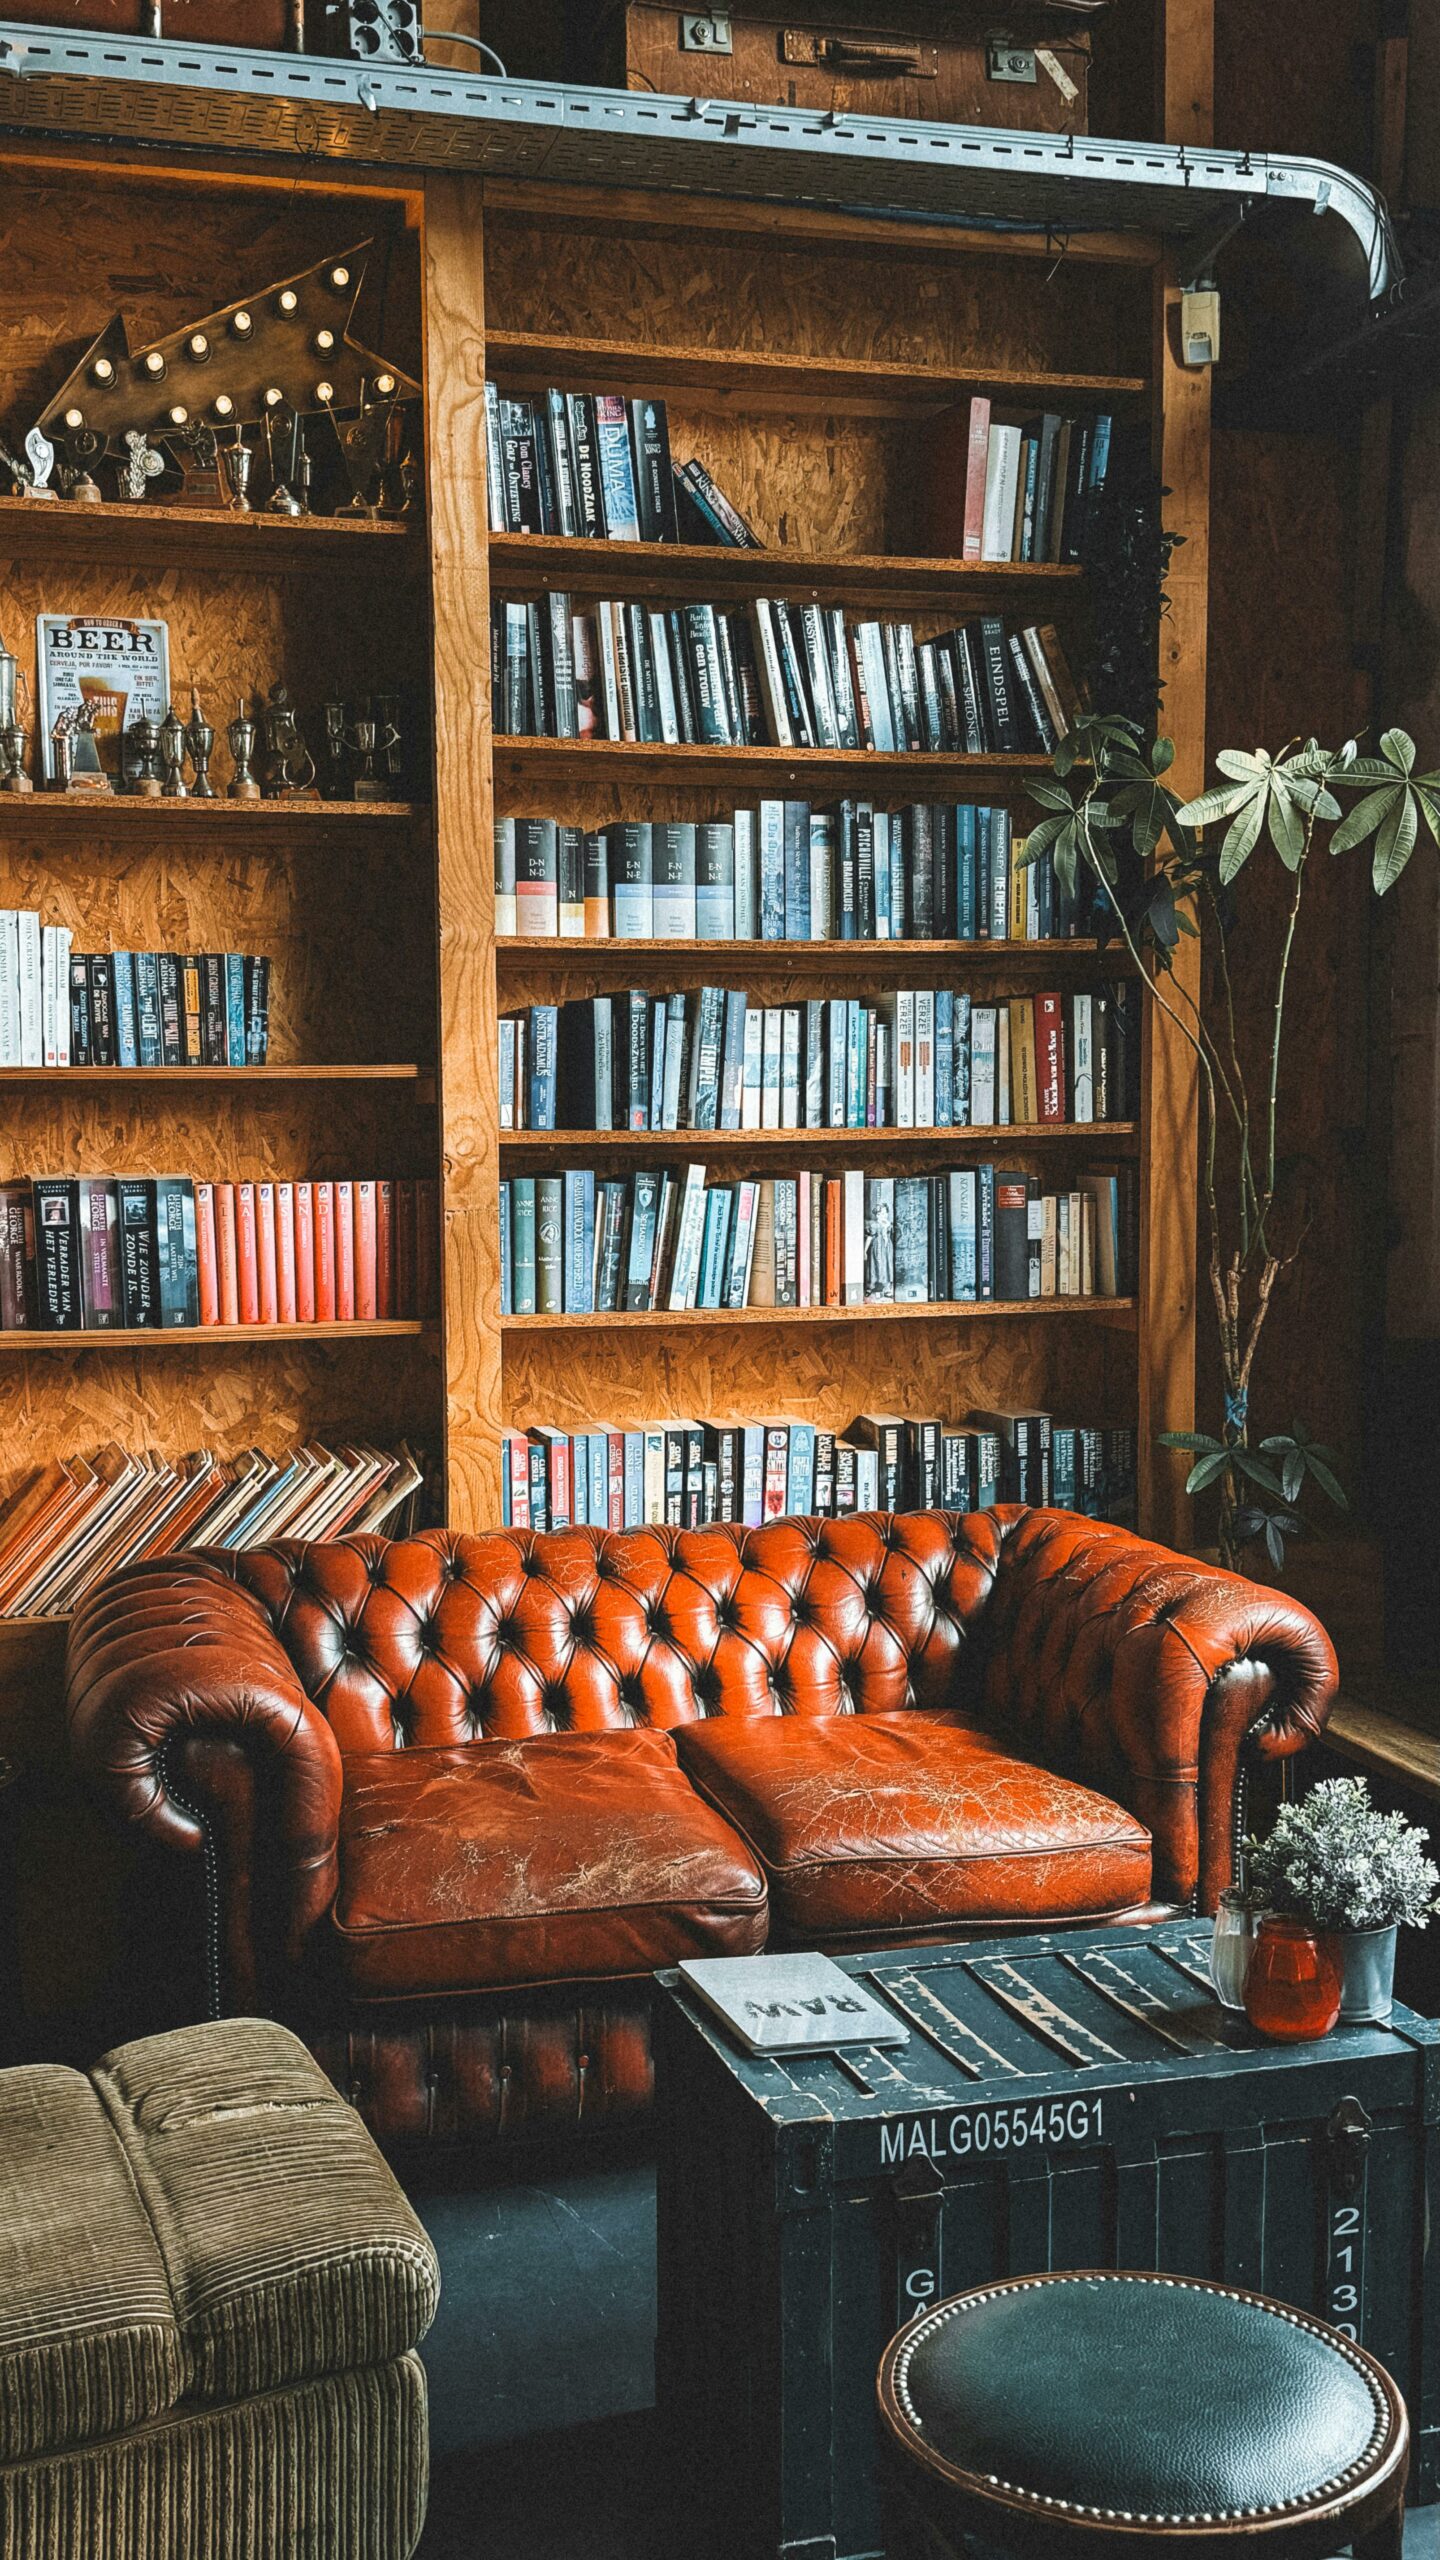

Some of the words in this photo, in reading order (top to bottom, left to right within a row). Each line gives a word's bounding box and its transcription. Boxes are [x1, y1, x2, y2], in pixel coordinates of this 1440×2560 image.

[519, 440, 531, 459] Tom
[604, 427, 626, 493] DUMA
[521, 461, 533, 490] Clancy
[508, 472, 522, 523] ONTZETTING
[581, 463, 596, 522] NOODZAAK
[729, 515, 749, 538] GREEN
[49, 629, 155, 652] BEER
[695, 644, 705, 667] een
[698, 668, 711, 708] vrouw
[989, 646, 1010, 727] EINDSPEL
[962, 687, 977, 738] SPELONK
[529, 858, 545, 867] D-N
[626, 861, 641, 870] E-N
[668, 862, 683, 870] F-N
[708, 863, 723, 871] E-N
[858, 829, 872, 881] PSYCHOVILLE
[529, 868, 546, 877] N-D
[626, 871, 642, 879] N-E
[668, 872, 683, 880] N-F
[708, 873, 723, 881] N-E
[843, 860, 854, 913] BRANDKLUIS
[569, 890, 577, 898] N
[114, 959, 125, 997] GRISHAM
[124, 965, 133, 988] JOHN
[138, 959, 148, 997] GRISHAM
[147, 965, 156, 988] JOHN
[160, 958, 169, 996] GRISHAM
[167, 964, 177, 987] JOHN
[206, 958, 218, 975] JOHN
[228, 954, 241, 973] JOHN
[101, 989, 109, 1022] ADVOCAAT
[208, 976, 219, 1006] GRISHAM
[230, 975, 242, 1005] GRISHAM
[94, 999, 102, 1023] DUIVEL
[121, 1003, 135, 1048] RAINMAKER
[141, 1013, 158, 1040] CLIENT
[899, 999, 908, 1036] VERZET
[917, 999, 927, 1036] VERZET
[164, 1029, 180, 1047] KILL
[535, 1012, 548, 1077] NOSTRADAMUS
[631, 1014, 640, 1091] DOODSZWAARD
[698, 1043, 718, 1087] TEMPEL
[90, 1194, 100, 1232] GEORGE
[98, 1194, 107, 1231] ELIZABETH
[168, 1194, 177, 1231] GEORGE
[175, 1194, 183, 1230] ELIZABETH
[241, 1206, 251, 1217] A
[319, 1205, 328, 1215] D
[779, 1182, 787, 1226] COOKSON
[960, 1177, 969, 1221] KONSALIK
[9, 1207, 18, 1245] GEORGE
[573, 1207, 584, 1240] HANCOCK
[45, 1230, 55, 1253] HET
[59, 1230, 70, 1286] VERRADER
[125, 1233, 136, 1275] ZONDE
[138, 1230, 150, 1254] WIE
[170, 1242, 178, 1269] LAATSTE
[93, 1252, 101, 1274] STILTE
[100, 1247, 109, 1287] VOLMAAKTE
[47, 1256, 58, 1313] VERLEDEN
[128, 1280, 138, 1304] IS...
[140, 1258, 151, 1308] ZONDER
[62, 1289, 71, 1312] VAN
[885, 1429, 898, 1465] LUDLUM
[924, 1426, 936, 1462] LUDLUM
[952, 1439, 960, 1449] De
[987, 1437, 995, 1453] Het
[1017, 1422, 1028, 1458] LUDLUM
[1043, 1418, 1051, 1449] LUDLUM
[1060, 1432, 1068, 1447] Het
[1089, 1431, 1097, 1450] Het
[626, 1443, 636, 1478] CUSSLER
[634, 1447, 642, 1472] CLIVE
[817, 1435, 826, 1473] SMITH
[823, 1435, 832, 1472] WILBUR
[838, 1451, 848, 1484] SMITH
[844, 1451, 854, 1484] WILBUR
[958, 1439, 966, 1476] LUDLUM
[979, 1437, 989, 1489] dubbelspel
[1066, 1432, 1074, 1472] LUDLUM
[1082, 1432, 1091, 1486] ultimatum
[1095, 1431, 1103, 1471] LUDLUM
[950, 1450, 960, 1493] Aquitaine
[986, 1454, 995, 1483] Jason
[1041, 1459, 1049, 1500] ARMAGEDDON
[1089, 1451, 1098, 1489] Medusa
[631, 1484, 640, 1514] ATLANTIS
[886, 1478, 896, 1497] Sigma
[534, 1508, 547, 1531] VUU
[744, 1994, 868, 2018] RAW
[880, 2098, 1103, 2164] MALG05545G1
